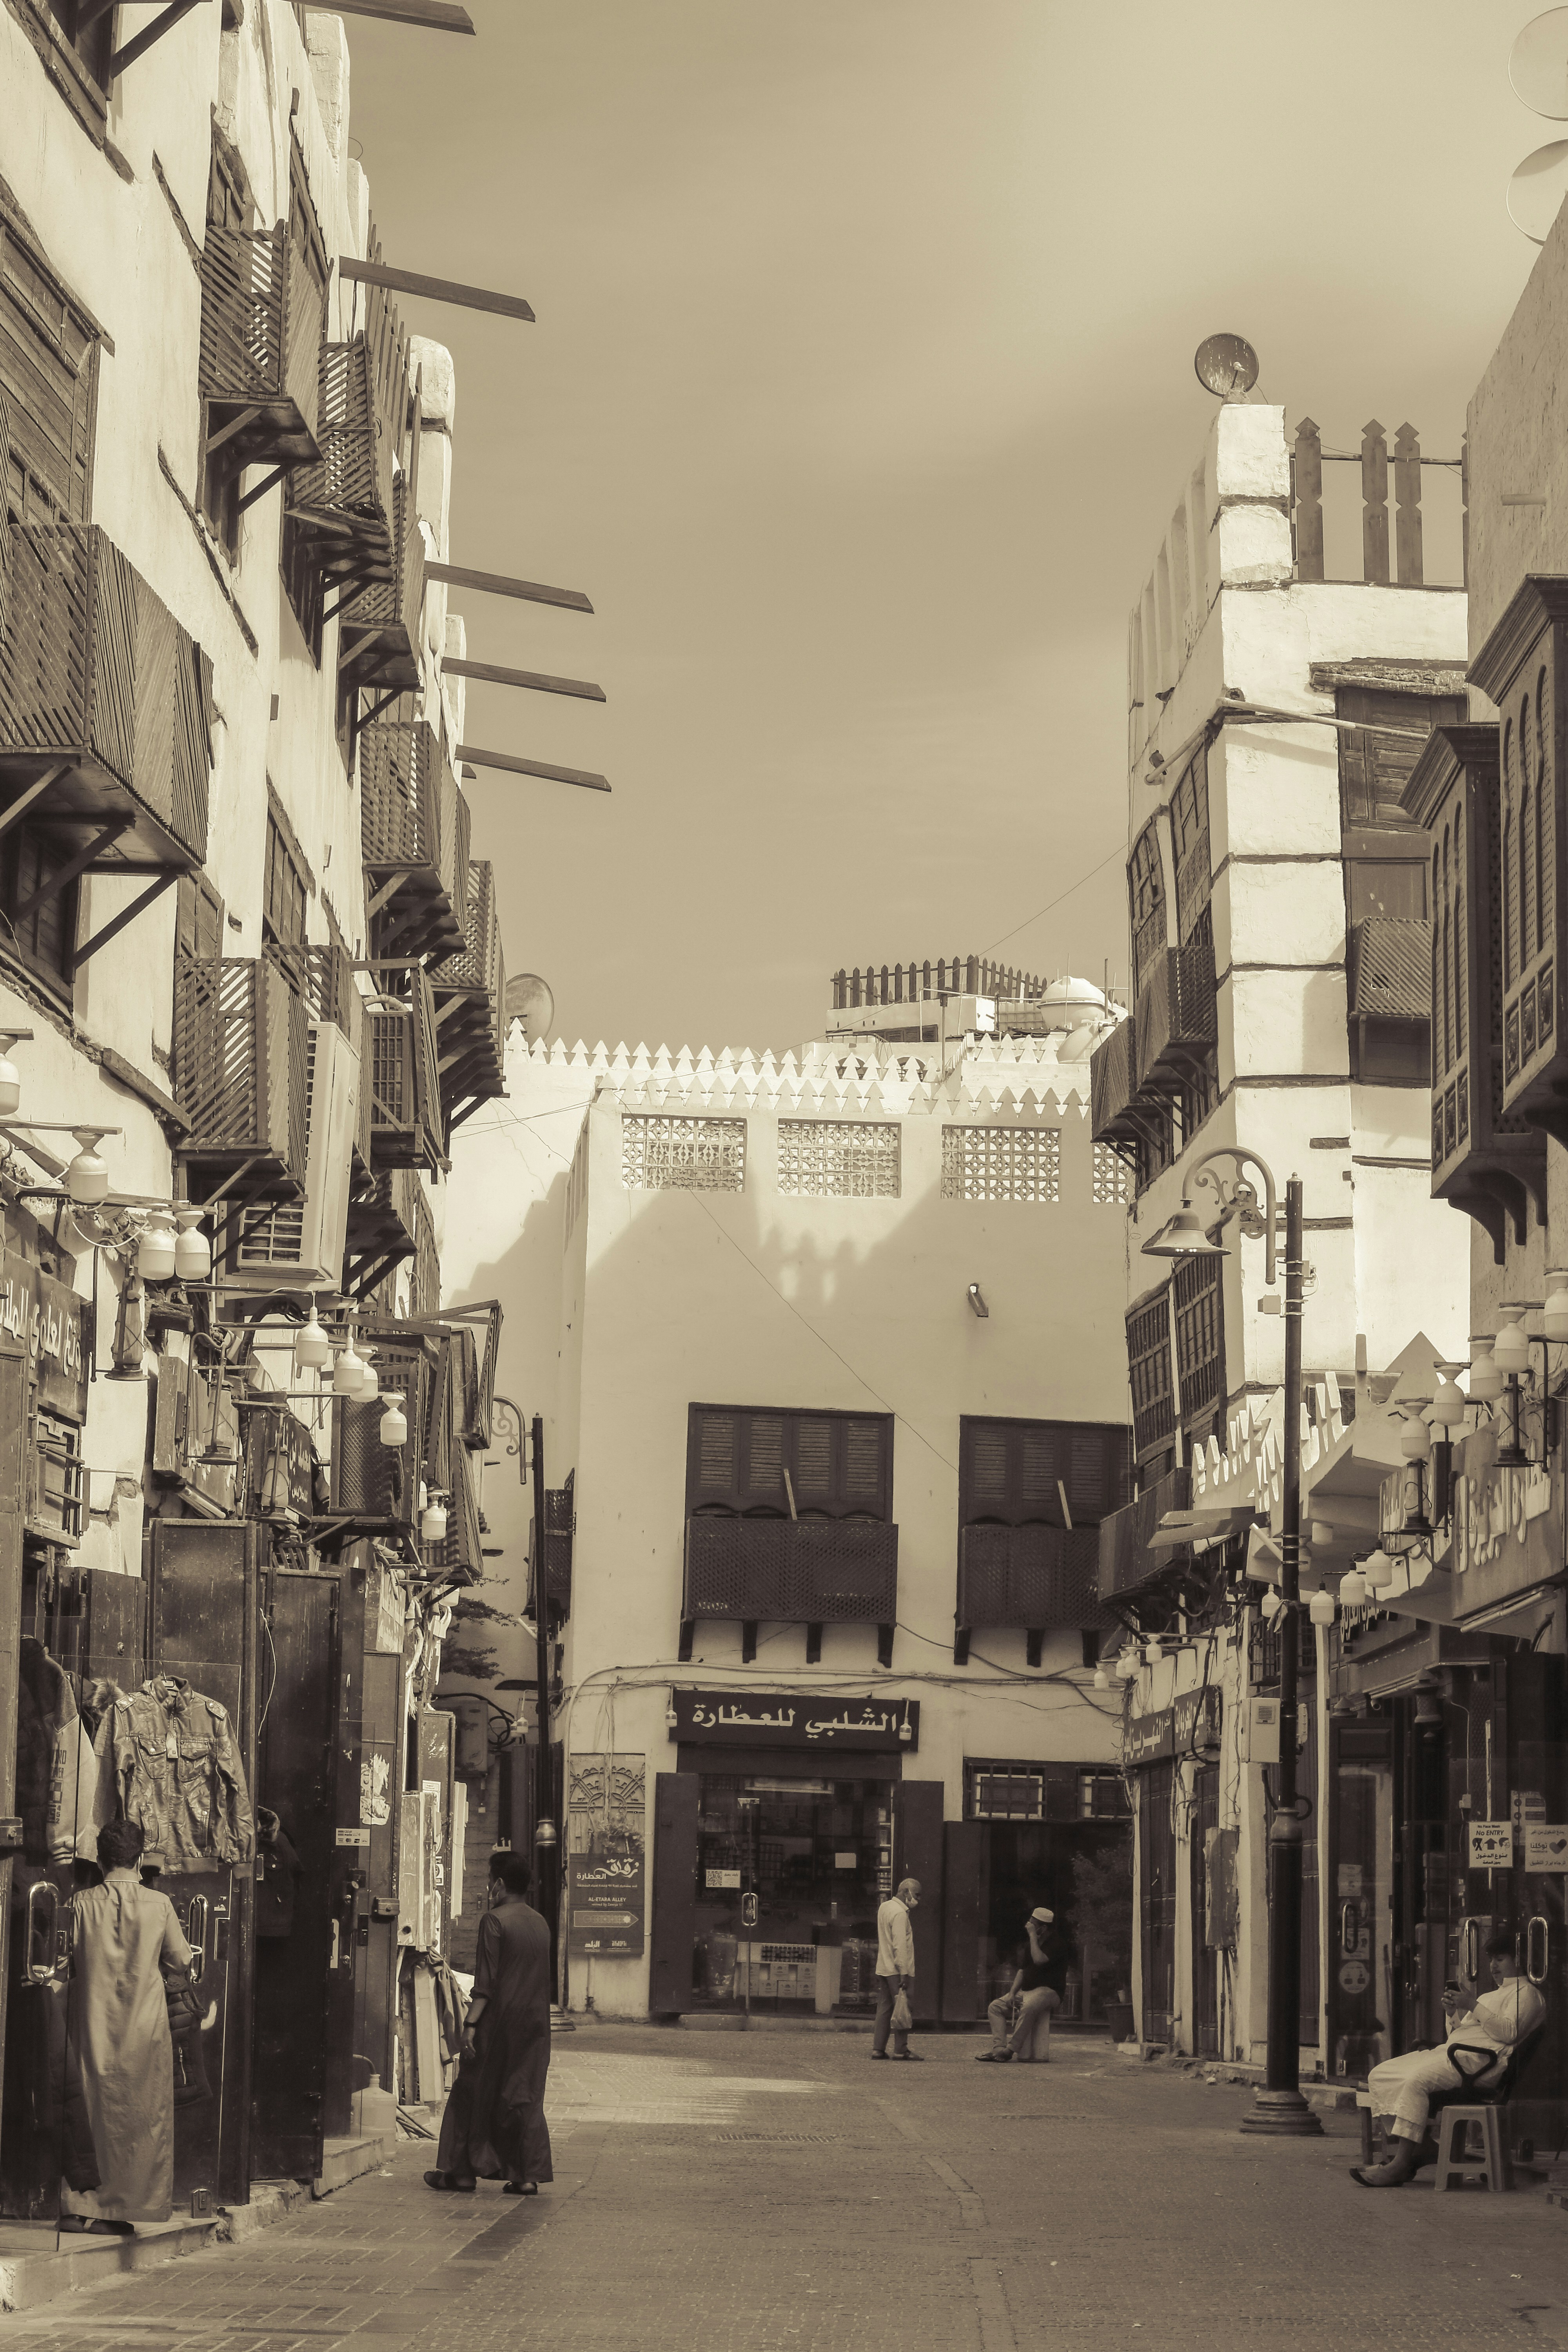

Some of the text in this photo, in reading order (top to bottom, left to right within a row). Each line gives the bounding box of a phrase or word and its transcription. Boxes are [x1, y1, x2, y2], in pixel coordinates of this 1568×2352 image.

[692, 1704, 897, 1739] الشلبي للعطارة
[576, 1858, 639, 1880] زقاق العطارة
